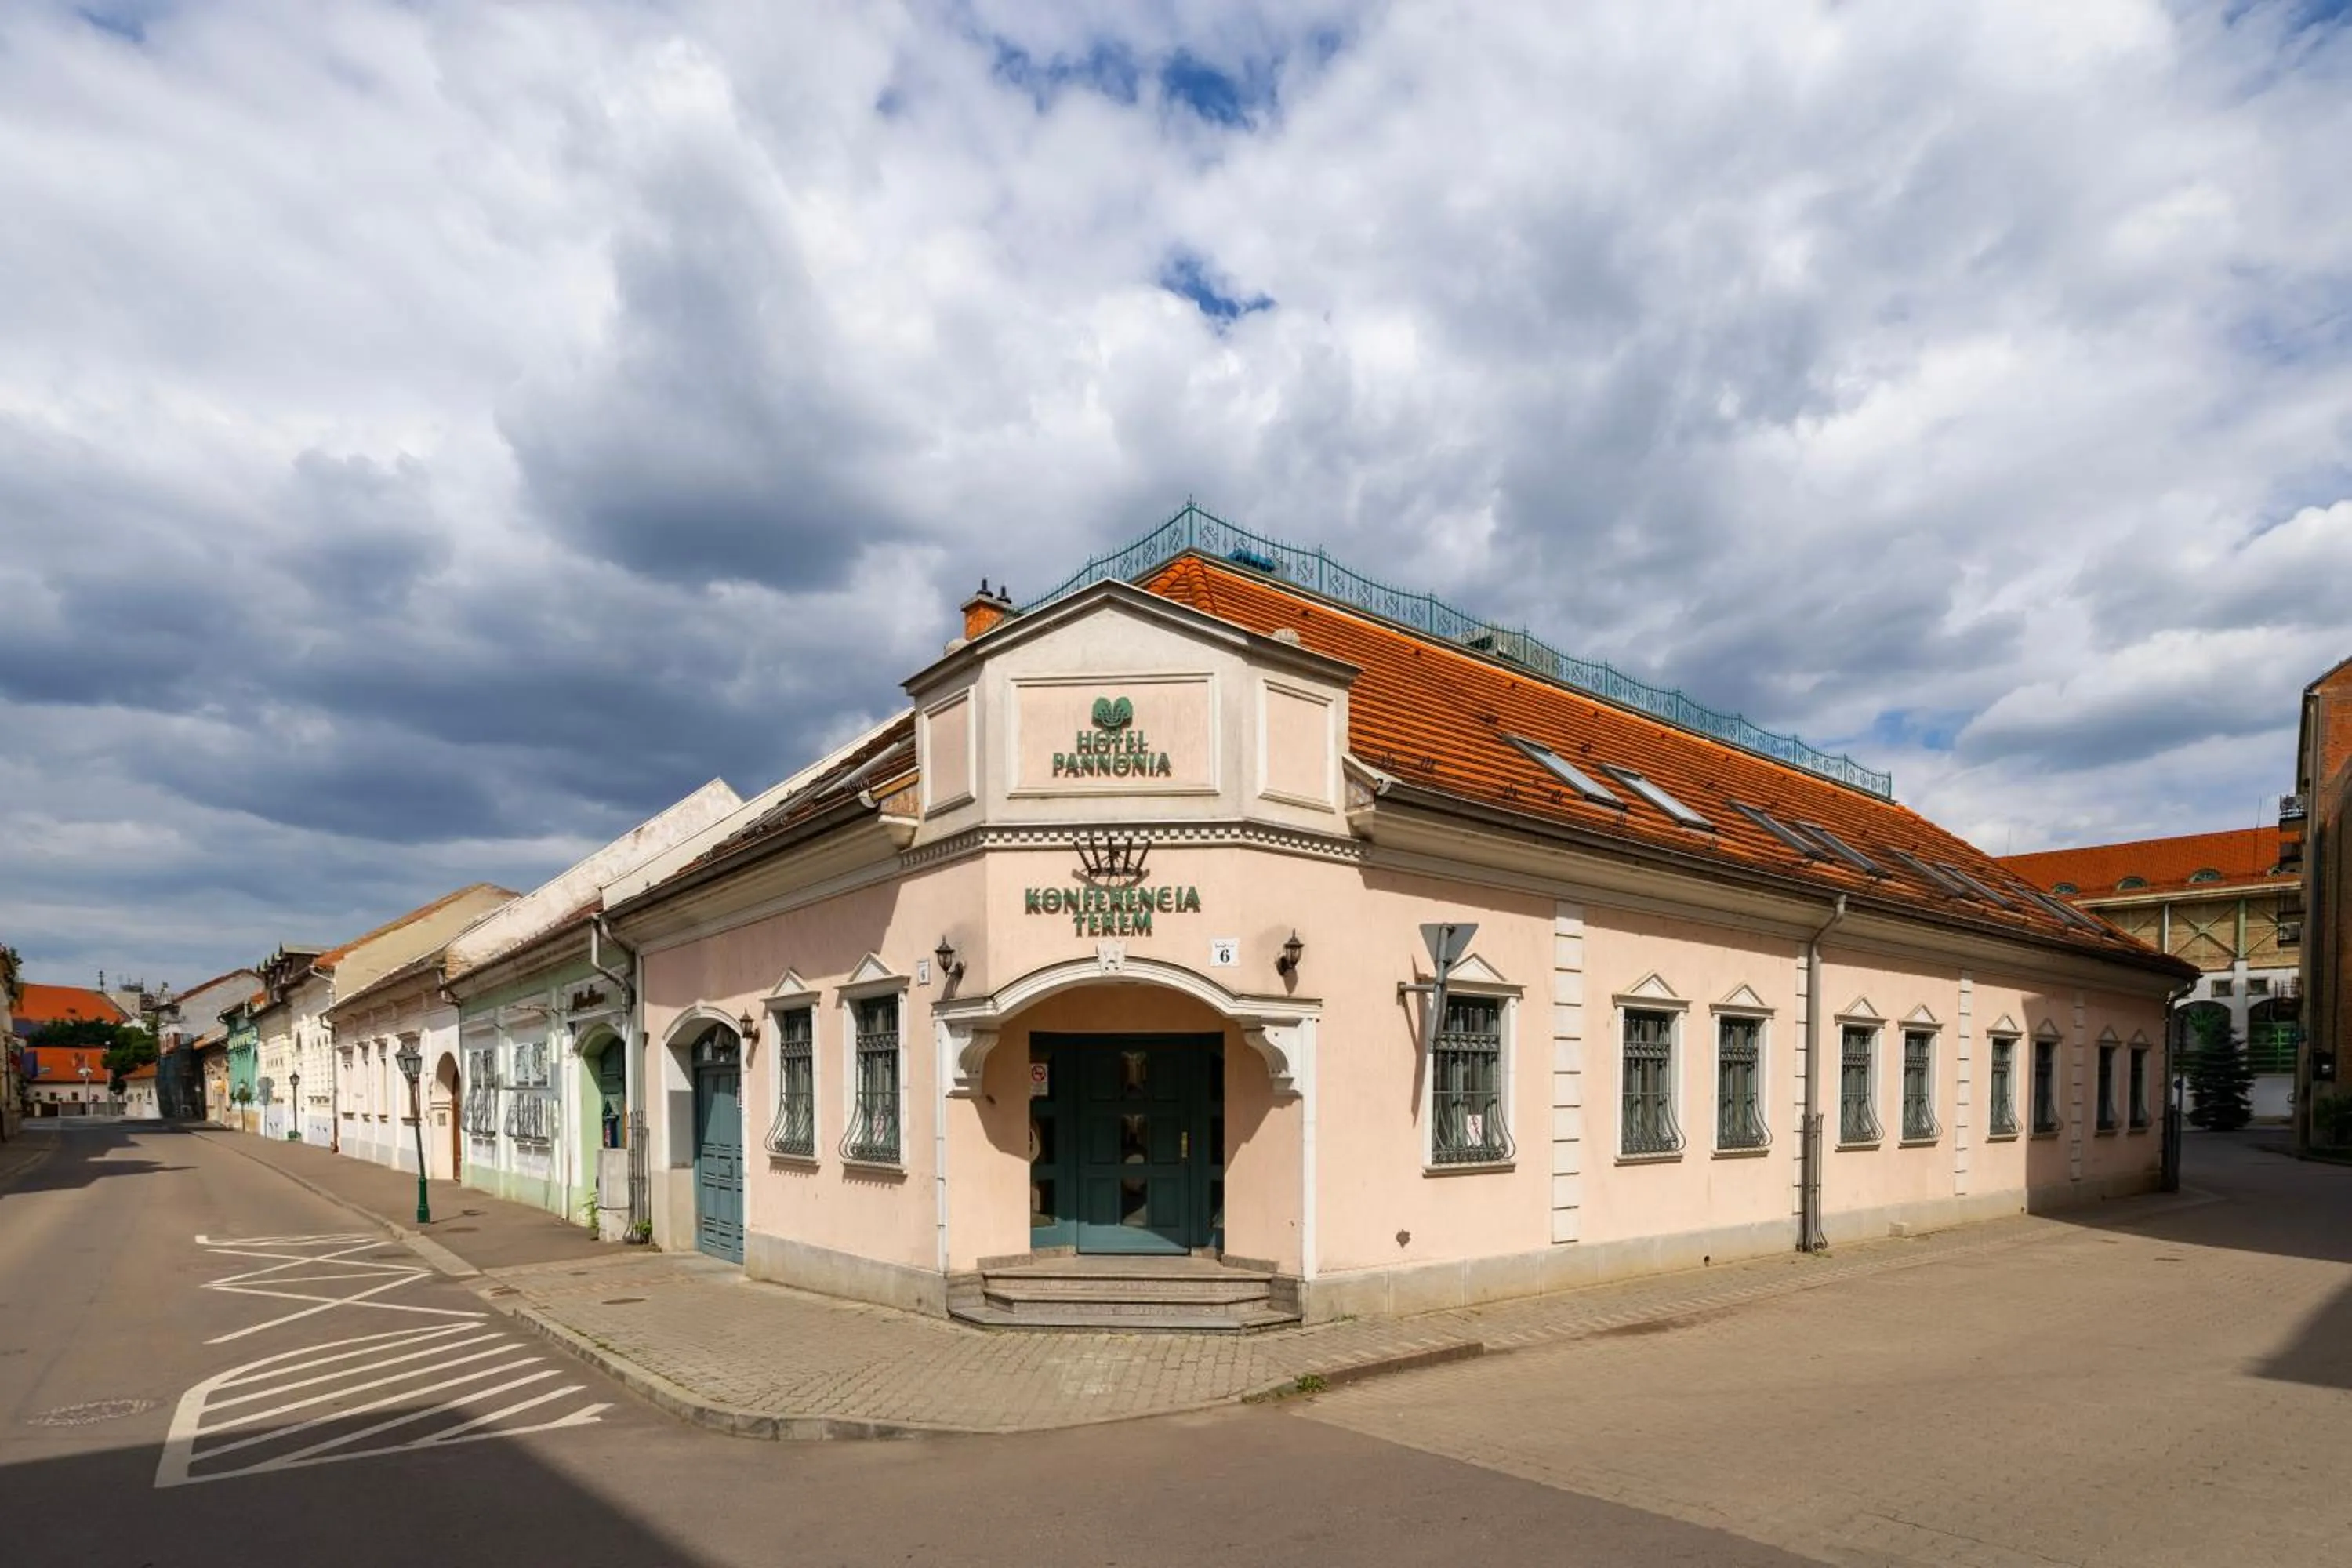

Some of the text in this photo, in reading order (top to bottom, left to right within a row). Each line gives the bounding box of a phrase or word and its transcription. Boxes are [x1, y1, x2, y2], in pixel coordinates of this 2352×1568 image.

[1076, 730, 1148, 749] HOTEL
[1053, 752, 1171, 771] PANNONIA
[1025, 886, 1200, 907] KONFERENCIA
[1073, 909, 1153, 931] TEREM
[1220, 949, 1229, 963] 6
